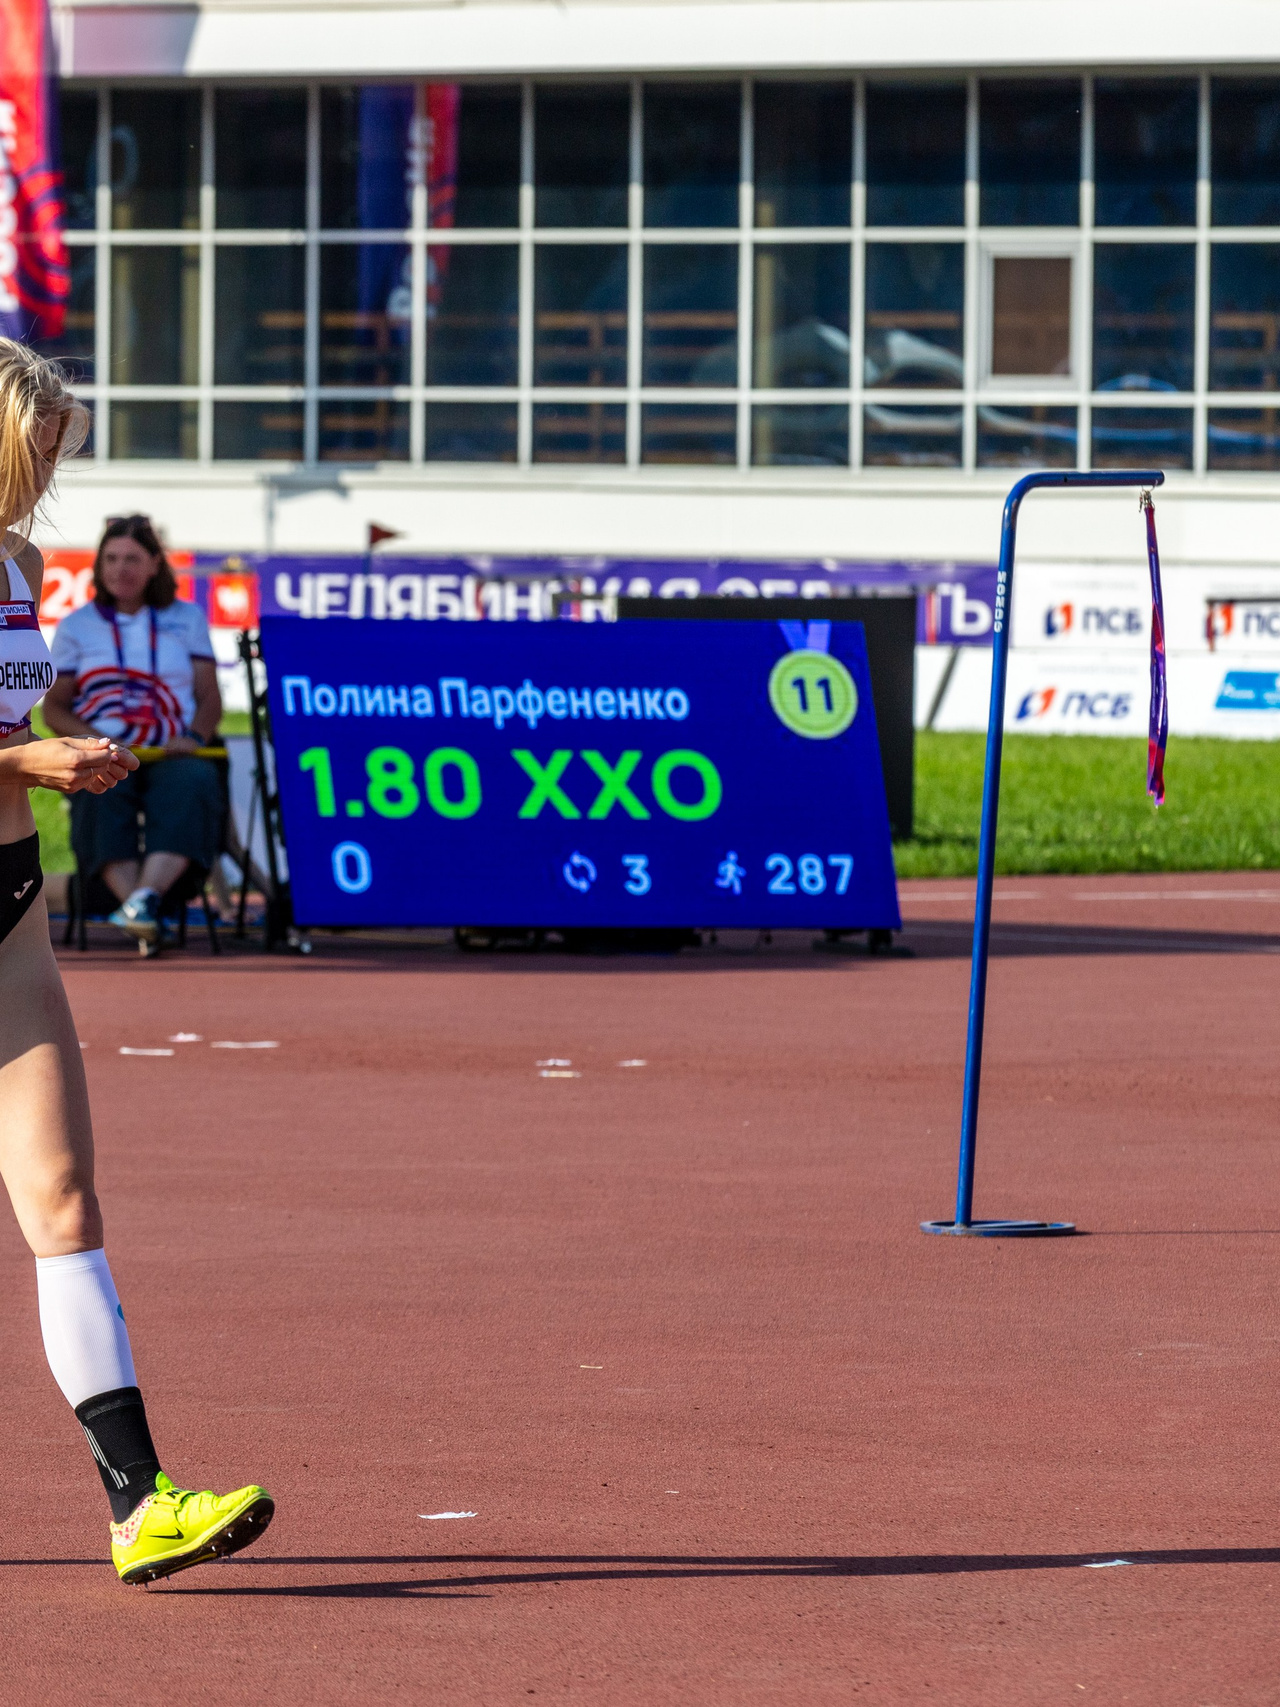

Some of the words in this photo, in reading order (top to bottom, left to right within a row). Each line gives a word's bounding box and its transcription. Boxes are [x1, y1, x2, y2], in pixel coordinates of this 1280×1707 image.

[1082, 606, 1142, 636] ПСБ
[281, 675, 434, 717] Полина
[438, 676, 690, 730] Парфененко
[790, 677, 834, 714] 11
[298, 745, 483, 820] 1.80
[510, 748, 723, 822] XXO
[622, 853, 652, 895] 3
[765, 852, 855, 896] 287
